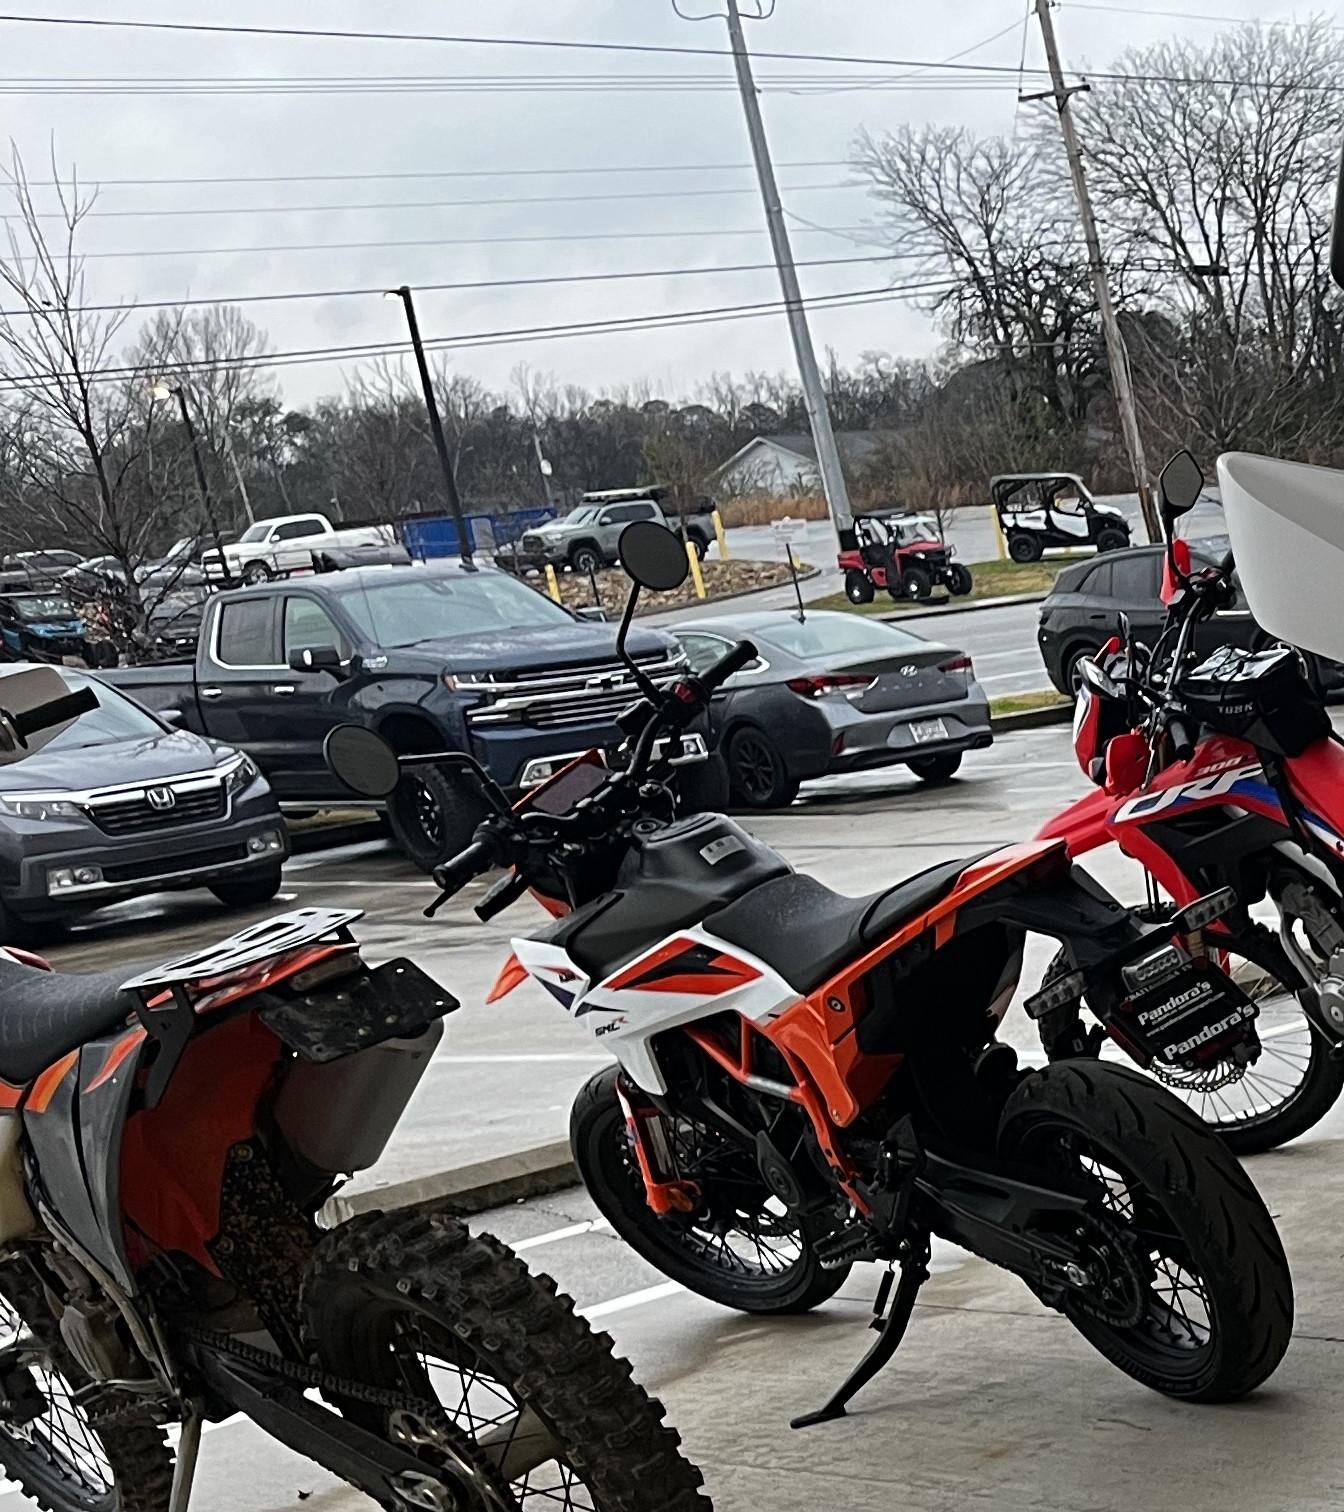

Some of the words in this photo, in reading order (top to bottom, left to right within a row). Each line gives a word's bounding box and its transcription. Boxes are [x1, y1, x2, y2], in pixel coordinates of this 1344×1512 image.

[1114, 762, 1264, 824] CRF
[1137, 981, 1211, 1026] Pandora's
[1163, 1003, 1255, 1060] Pandora's
